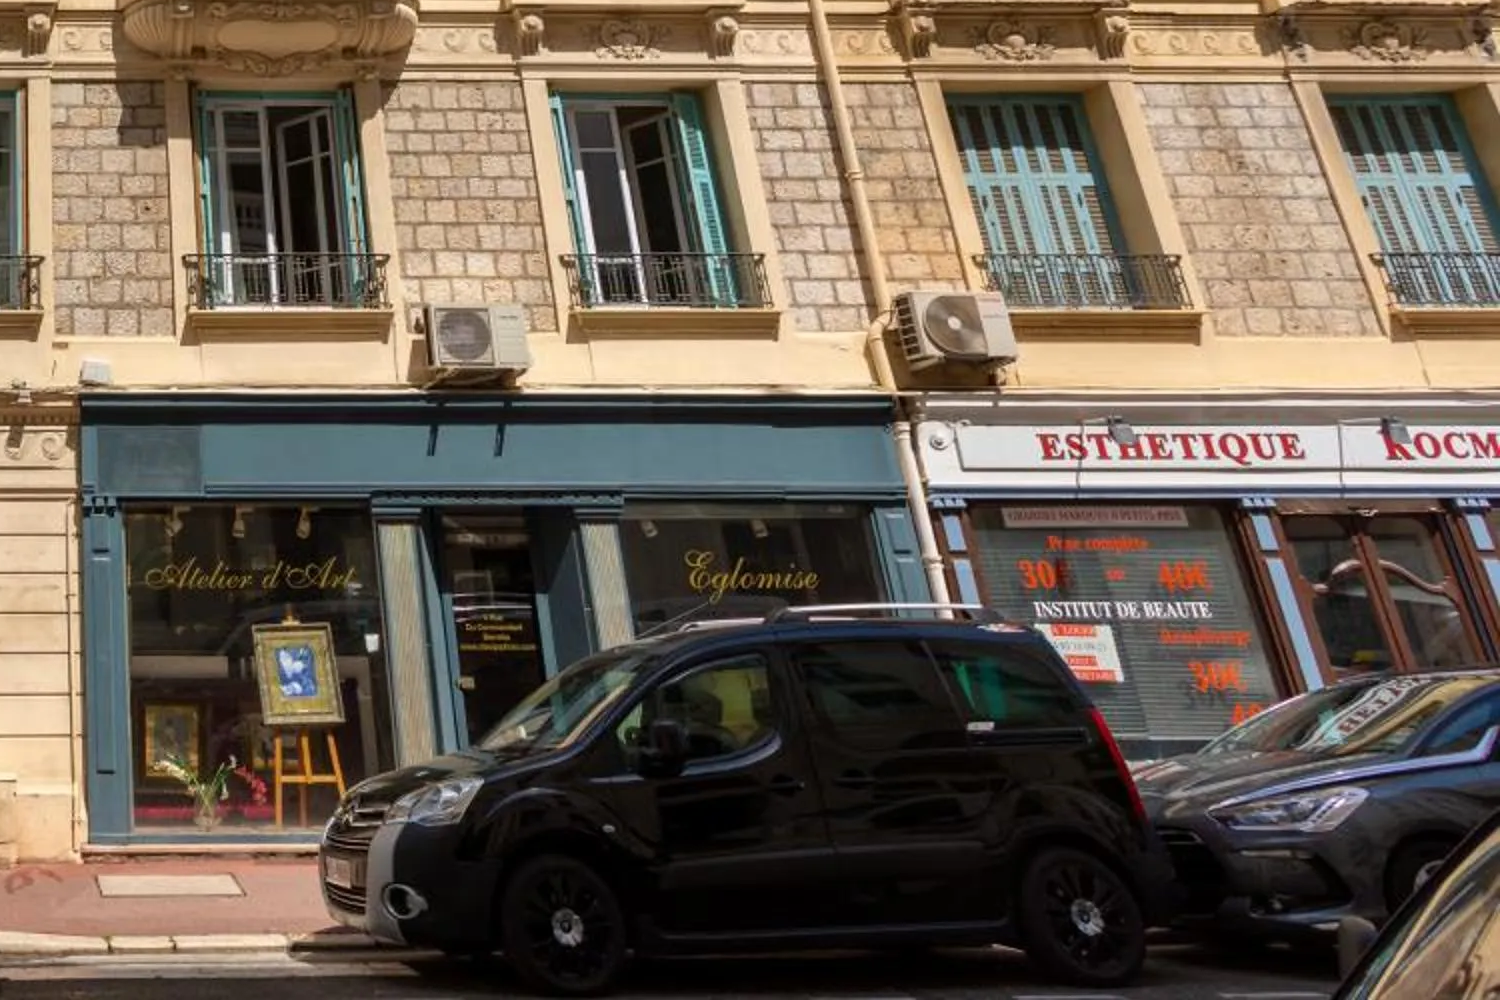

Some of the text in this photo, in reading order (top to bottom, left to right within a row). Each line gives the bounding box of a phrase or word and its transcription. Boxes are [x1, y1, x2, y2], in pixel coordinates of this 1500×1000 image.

[1036, 432, 1305, 465] ESTHETIQUE
[145, 556, 357, 590] Atelier d'Art
[1033, 601, 1213, 619] INSTITUT DE BEAUTE
